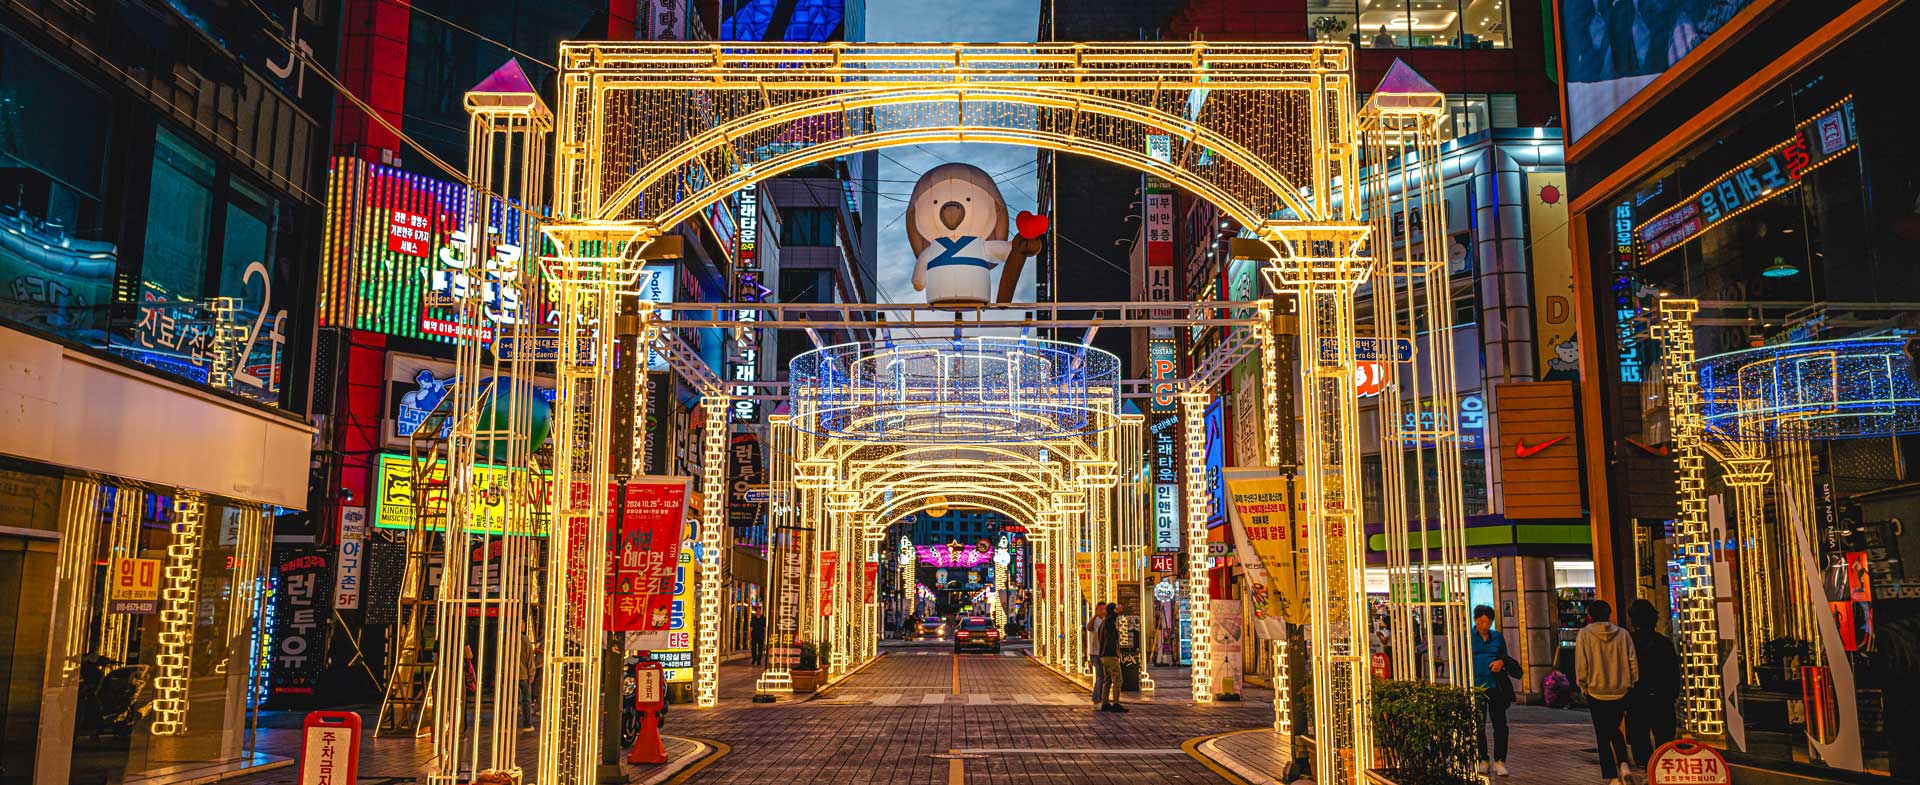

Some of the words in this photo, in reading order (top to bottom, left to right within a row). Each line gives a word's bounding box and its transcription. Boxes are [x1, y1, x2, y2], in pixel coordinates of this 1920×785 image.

[1150, 198, 1170, 209] 피부
[1150, 213, 1170, 225] 비만
[1150, 229, 1170, 241] 통증
[233, 261, 288, 392] 2f
[1155, 360, 1174, 406] PC
[647, 381, 657, 416] OLIVE
[645, 432, 655, 472] YOUNG
[1157, 433, 1174, 481] 노래타운
[382, 507, 416, 516] KINGKOG
[627, 500, 641, 508] 2024
[1157, 486, 1172, 545] 인앤아웃
[1826, 506, 1833, 521] ON
[381, 515, 416, 523] MUSICTON
[1270, 525, 1285, 540] 알림
[121, 560, 155, 588] 임대
[340, 541, 360, 591] 야구존
[338, 594, 356, 605] 5F
[619, 594, 649, 619] 축제
[277, 573, 317, 670] 런투유
[669, 632, 689, 648] 타운
[318, 731, 337, 785] 주차금지
